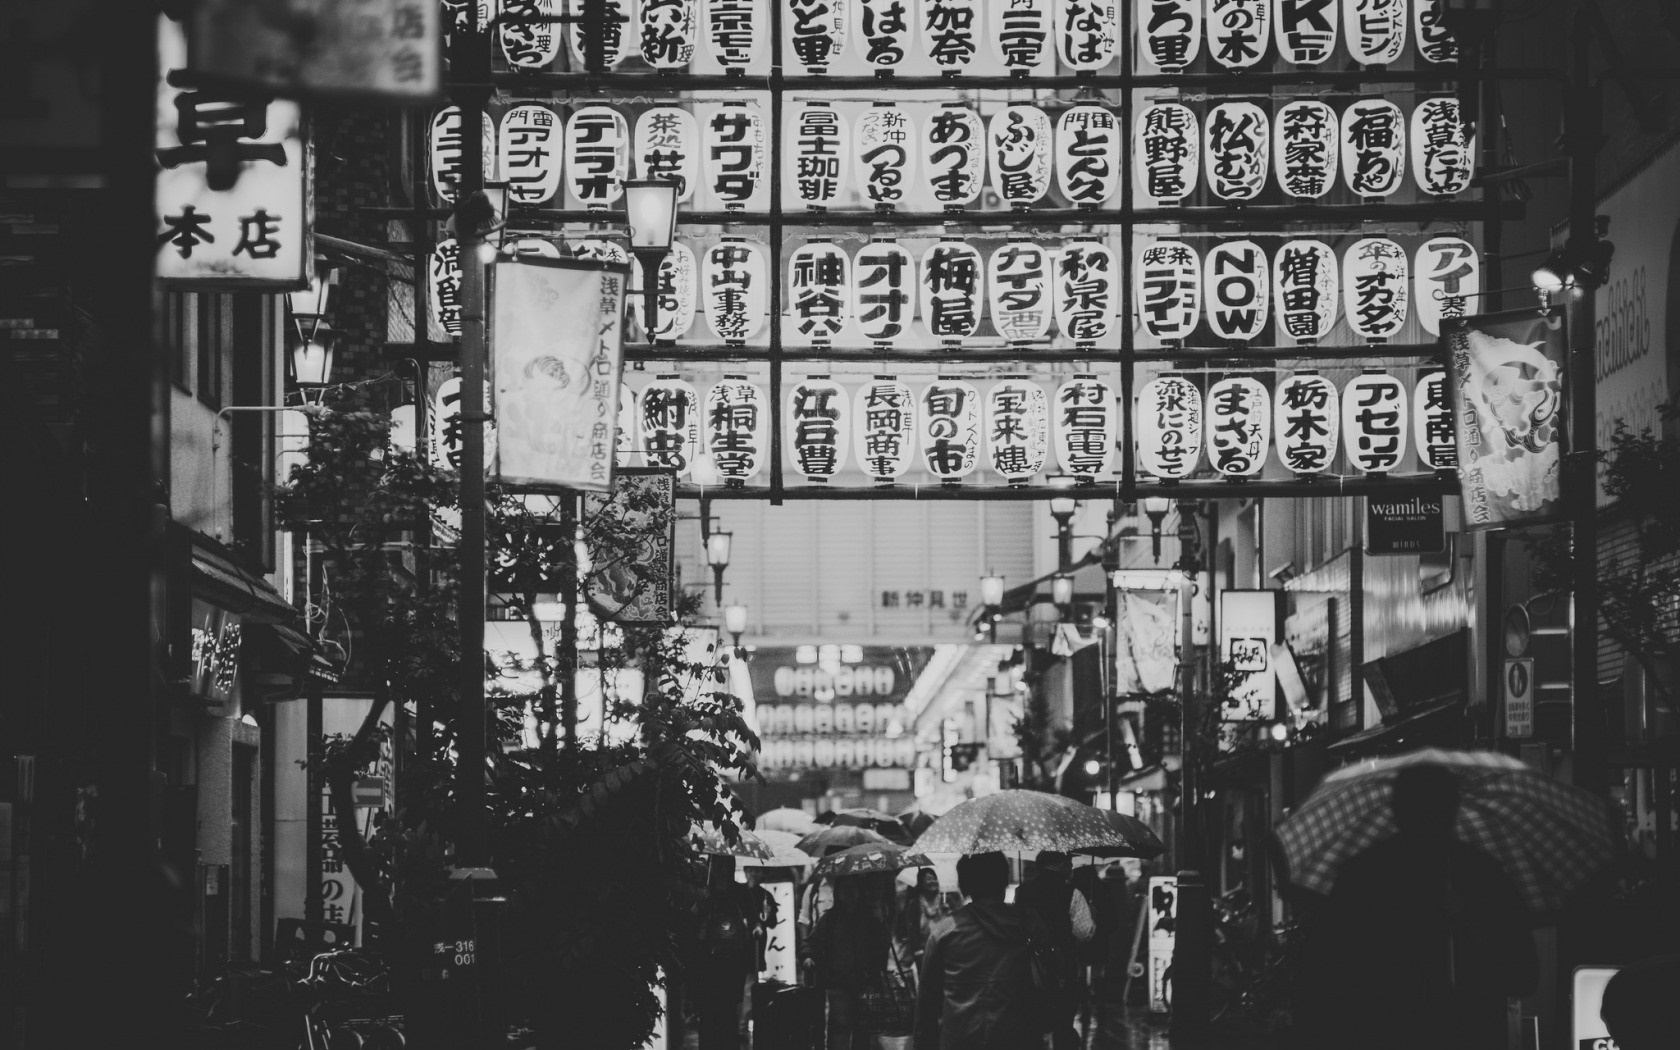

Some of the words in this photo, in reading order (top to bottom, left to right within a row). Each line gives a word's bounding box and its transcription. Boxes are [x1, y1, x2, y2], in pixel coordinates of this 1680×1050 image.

[861, 0, 907, 65] はる
[925, 0, 976, 65] 加奈
[1064, 0, 1105, 65] なば
[710, 113, 760, 201] サワダ
[860, 144, 907, 202] つるや
[929, 111, 972, 201] あづま
[995, 110, 1038, 200] ふじ屋
[1142, 106, 1187, 198] 熊野屋
[1209, 109, 1255, 198] 松むら
[157, 204, 283, 260] 本店
[710, 245, 753, 338] 中山事務所
[1059, 247, 1109, 339] 和泉屋
[1214, 248, 1256, 335] NOW
[1279, 246, 1321, 337] 増田園
[710, 384, 757, 404] 浅草
[864, 384, 903, 476] 長岡商事
[923, 385, 967, 475] 旬の市
[1060, 383, 1109, 474] 村石電気
[1155, 380, 1188, 475] 流氷にのせて
[1213, 383, 1251, 473] まさる
[1371, 496, 1441, 516] wamiles
